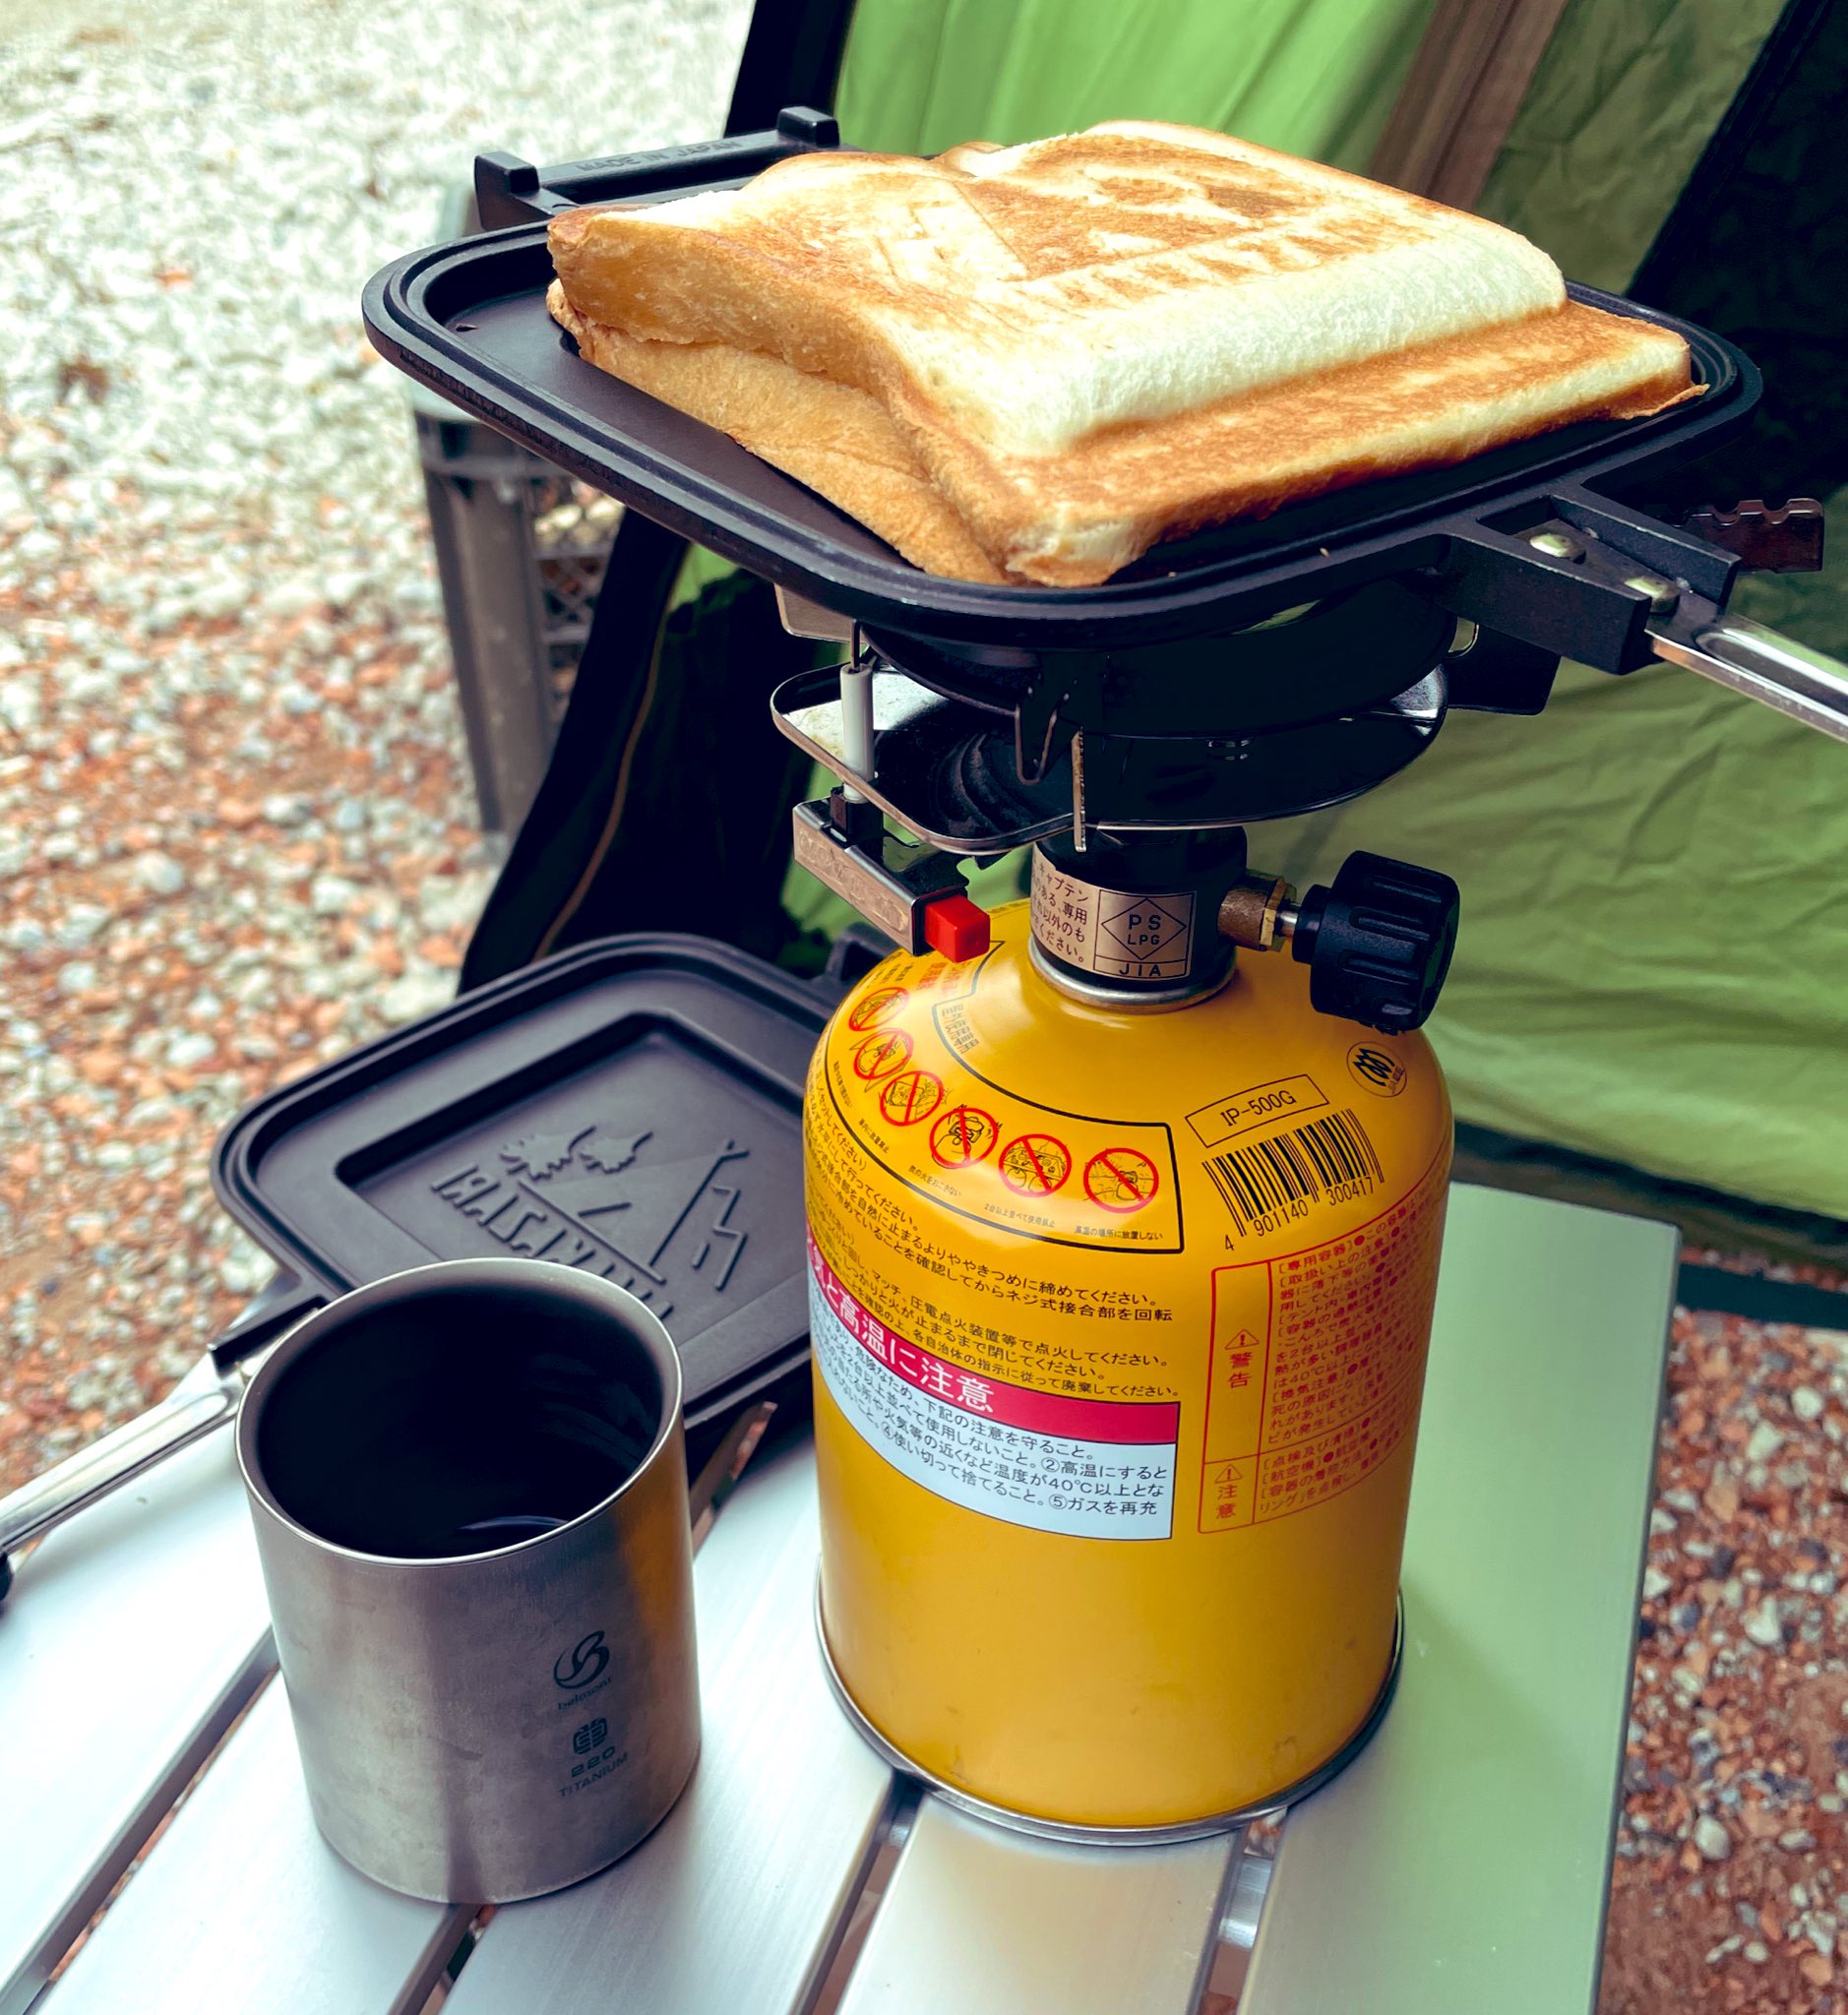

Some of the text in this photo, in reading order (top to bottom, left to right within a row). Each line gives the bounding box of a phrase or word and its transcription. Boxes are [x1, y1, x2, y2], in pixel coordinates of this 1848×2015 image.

[578, 141, 742, 172] MADE IN JAPAN
[1128, 914, 1162, 931] PS
[1127, 934, 1161, 946] LPG
[1118, 962, 1163, 977] JIA
[1219, 1089, 1298, 1128] IP-500G
[1223, 1176, 1375, 1252] 4 901140 300417
[1228, 1351, 1254, 1389] 警告
[1215, 1484, 1238, 1520] 注意
[559, 1751, 629, 1798] TITANIUM
[571, 1745, 616, 1778] 220
